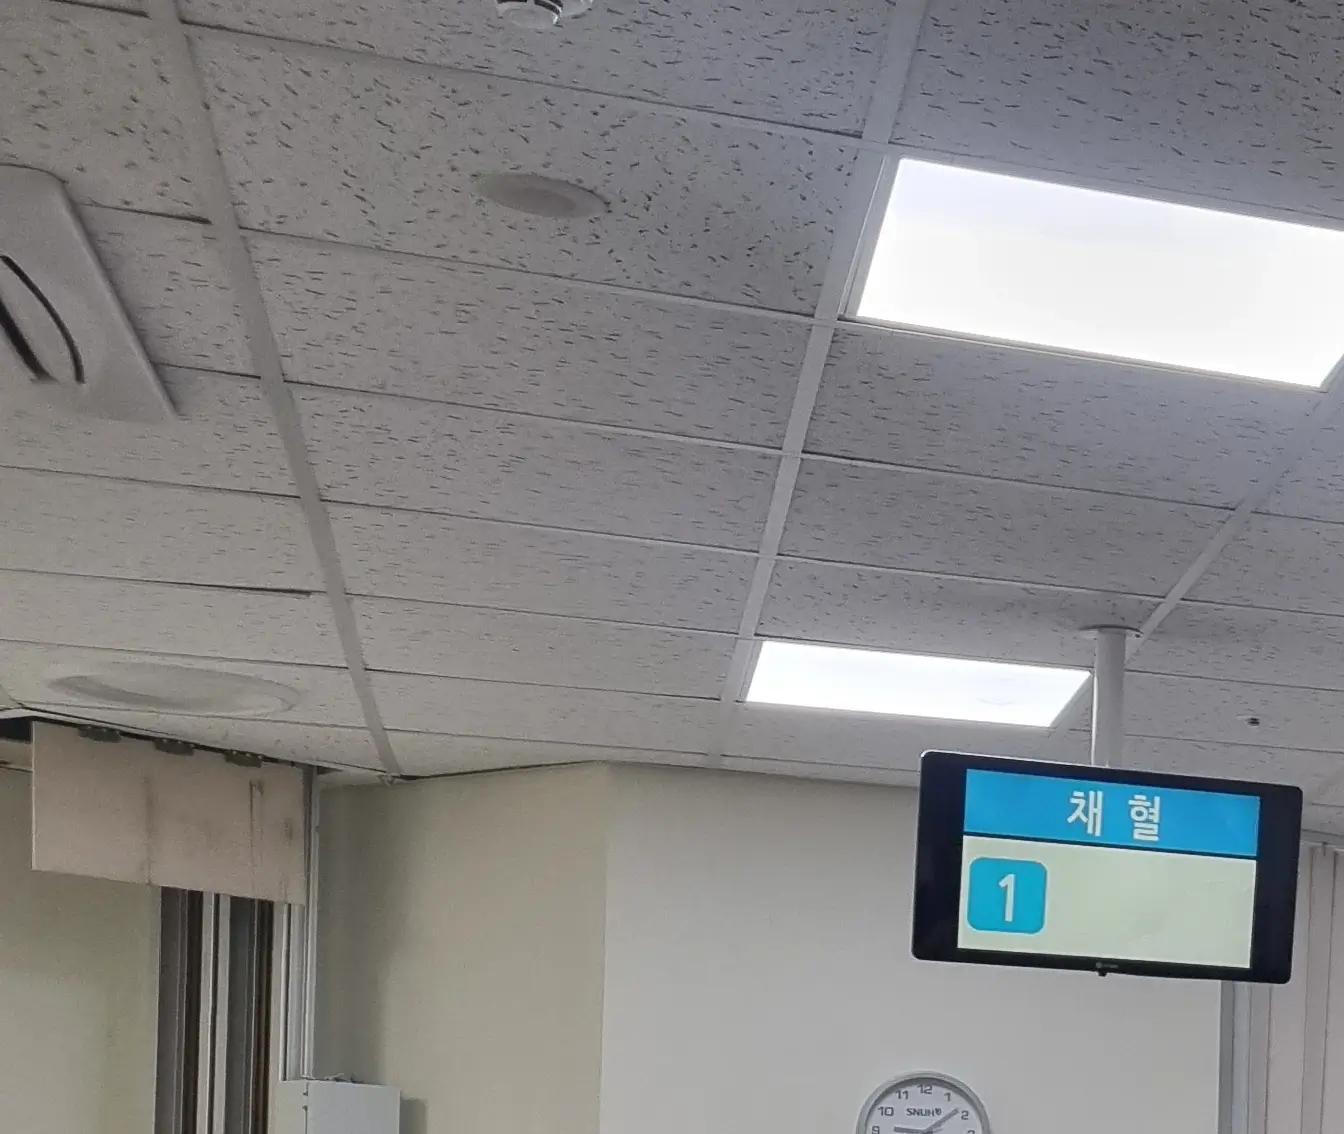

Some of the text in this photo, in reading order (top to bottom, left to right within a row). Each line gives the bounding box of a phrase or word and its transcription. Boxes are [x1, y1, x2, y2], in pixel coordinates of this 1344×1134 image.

[998, 873, 1016, 922] 1
[917, 1085, 932, 1094] 12
[896, 1091, 909, 1100] 11
[945, 1092, 951, 1101] 1
[878, 1107, 894, 1117] 10
[906, 1108, 934, 1117] SNUH
[961, 1111, 968, 1120] 2
